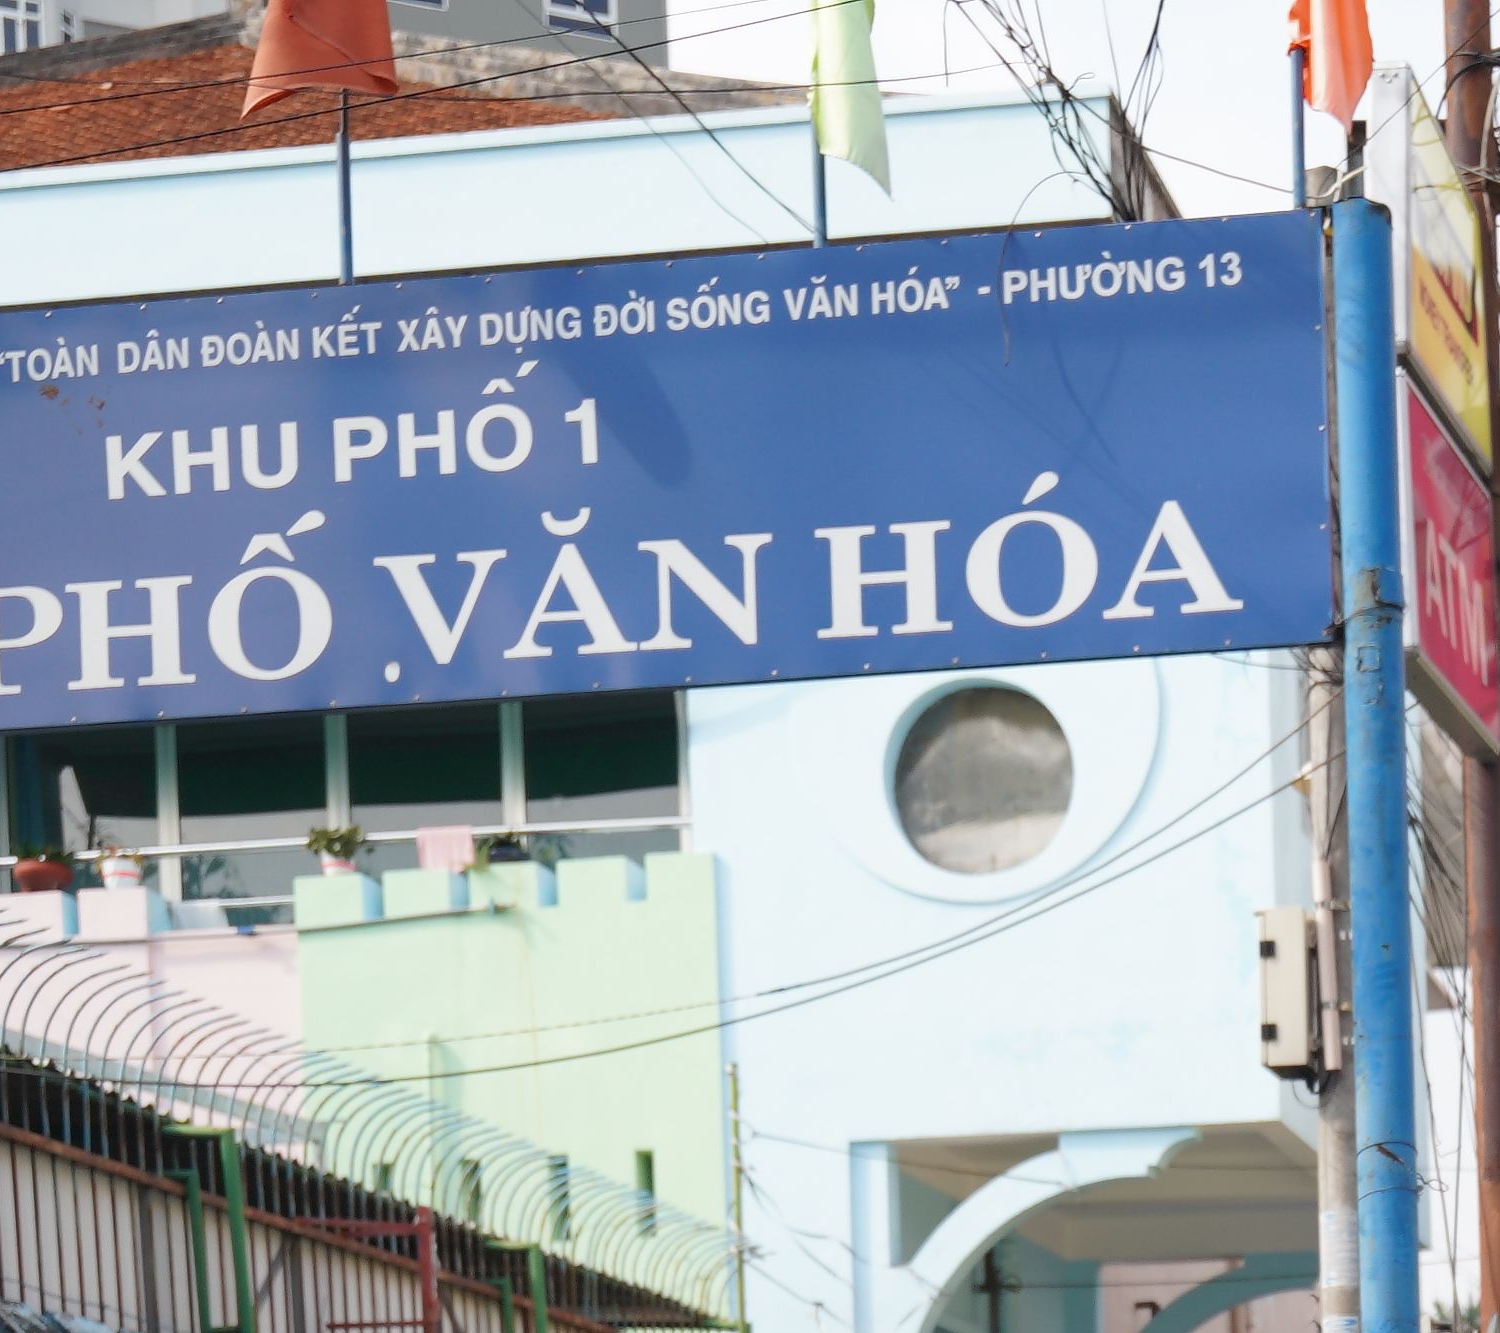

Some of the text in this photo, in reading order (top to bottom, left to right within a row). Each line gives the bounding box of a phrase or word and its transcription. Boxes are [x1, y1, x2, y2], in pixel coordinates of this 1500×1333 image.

[117, 326, 188, 374] DÂN
[201, 322, 299, 367] ĐOÀN
[311, 304, 380, 358] KẾT
[397, 302, 463, 353] XÂY
[480, 302, 582, 355] DỰNG
[594, 285, 656, 337] ĐỜI
[667, 275, 771, 330] SỐNG
[784, 275, 860, 321] VĂN
[1002, 256, 1187, 306] PHƯỜNG
[1201, 252, 1243, 288] 13
[105, 361, 599, 500] KHU PHỐ 1
[814, 472, 1244, 639] HÓA
[1426, 517, 1488, 687] ATM
